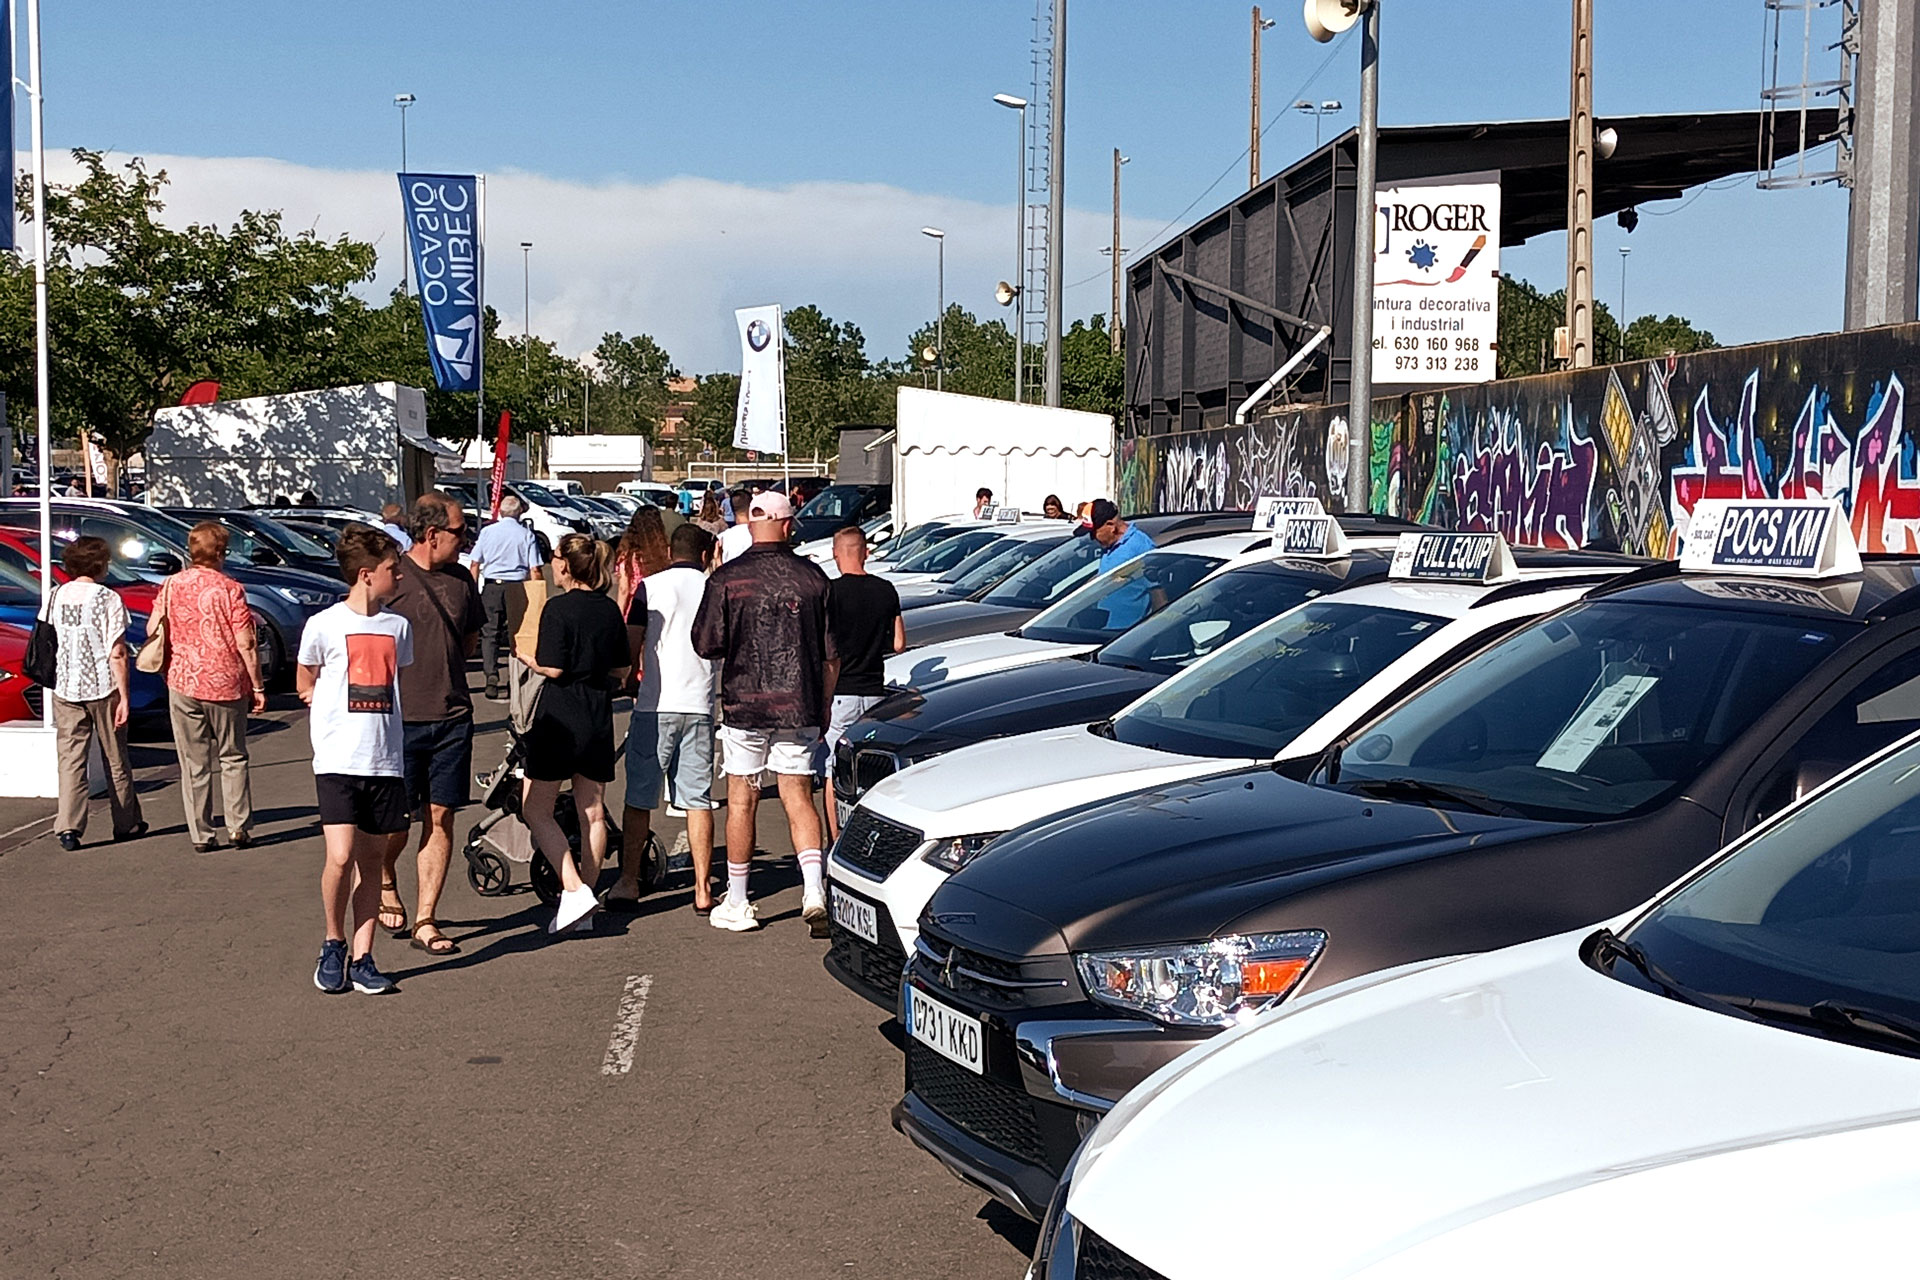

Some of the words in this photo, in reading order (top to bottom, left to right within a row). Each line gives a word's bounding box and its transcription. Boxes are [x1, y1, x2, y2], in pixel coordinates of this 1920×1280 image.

[1391, 204, 1491, 232] ROGER
[1373, 297, 1412, 310] intura
[1419, 297, 1491, 312] decorativa
[1391, 316, 1395, 330] i
[1401, 317, 1464, 331] industrial
[1372, 336, 1388, 350] el.
[1394, 337, 1419, 350] 630
[1426, 337, 1448, 350] 160
[1455, 337, 1480, 351] 968
[1395, 356, 1419, 370] 973
[1426, 357, 1447, 371] 313
[1454, 357, 1479, 371] 238
[1285, 520, 1311, 548] POCS
[1716, 508, 1784, 556] POCS
[1781, 509, 1826, 557] KM
[1414, 536, 1450, 568] FULL
[1447, 536, 1493, 571] EQUIP
[948, 1015, 978, 1064] KKD
